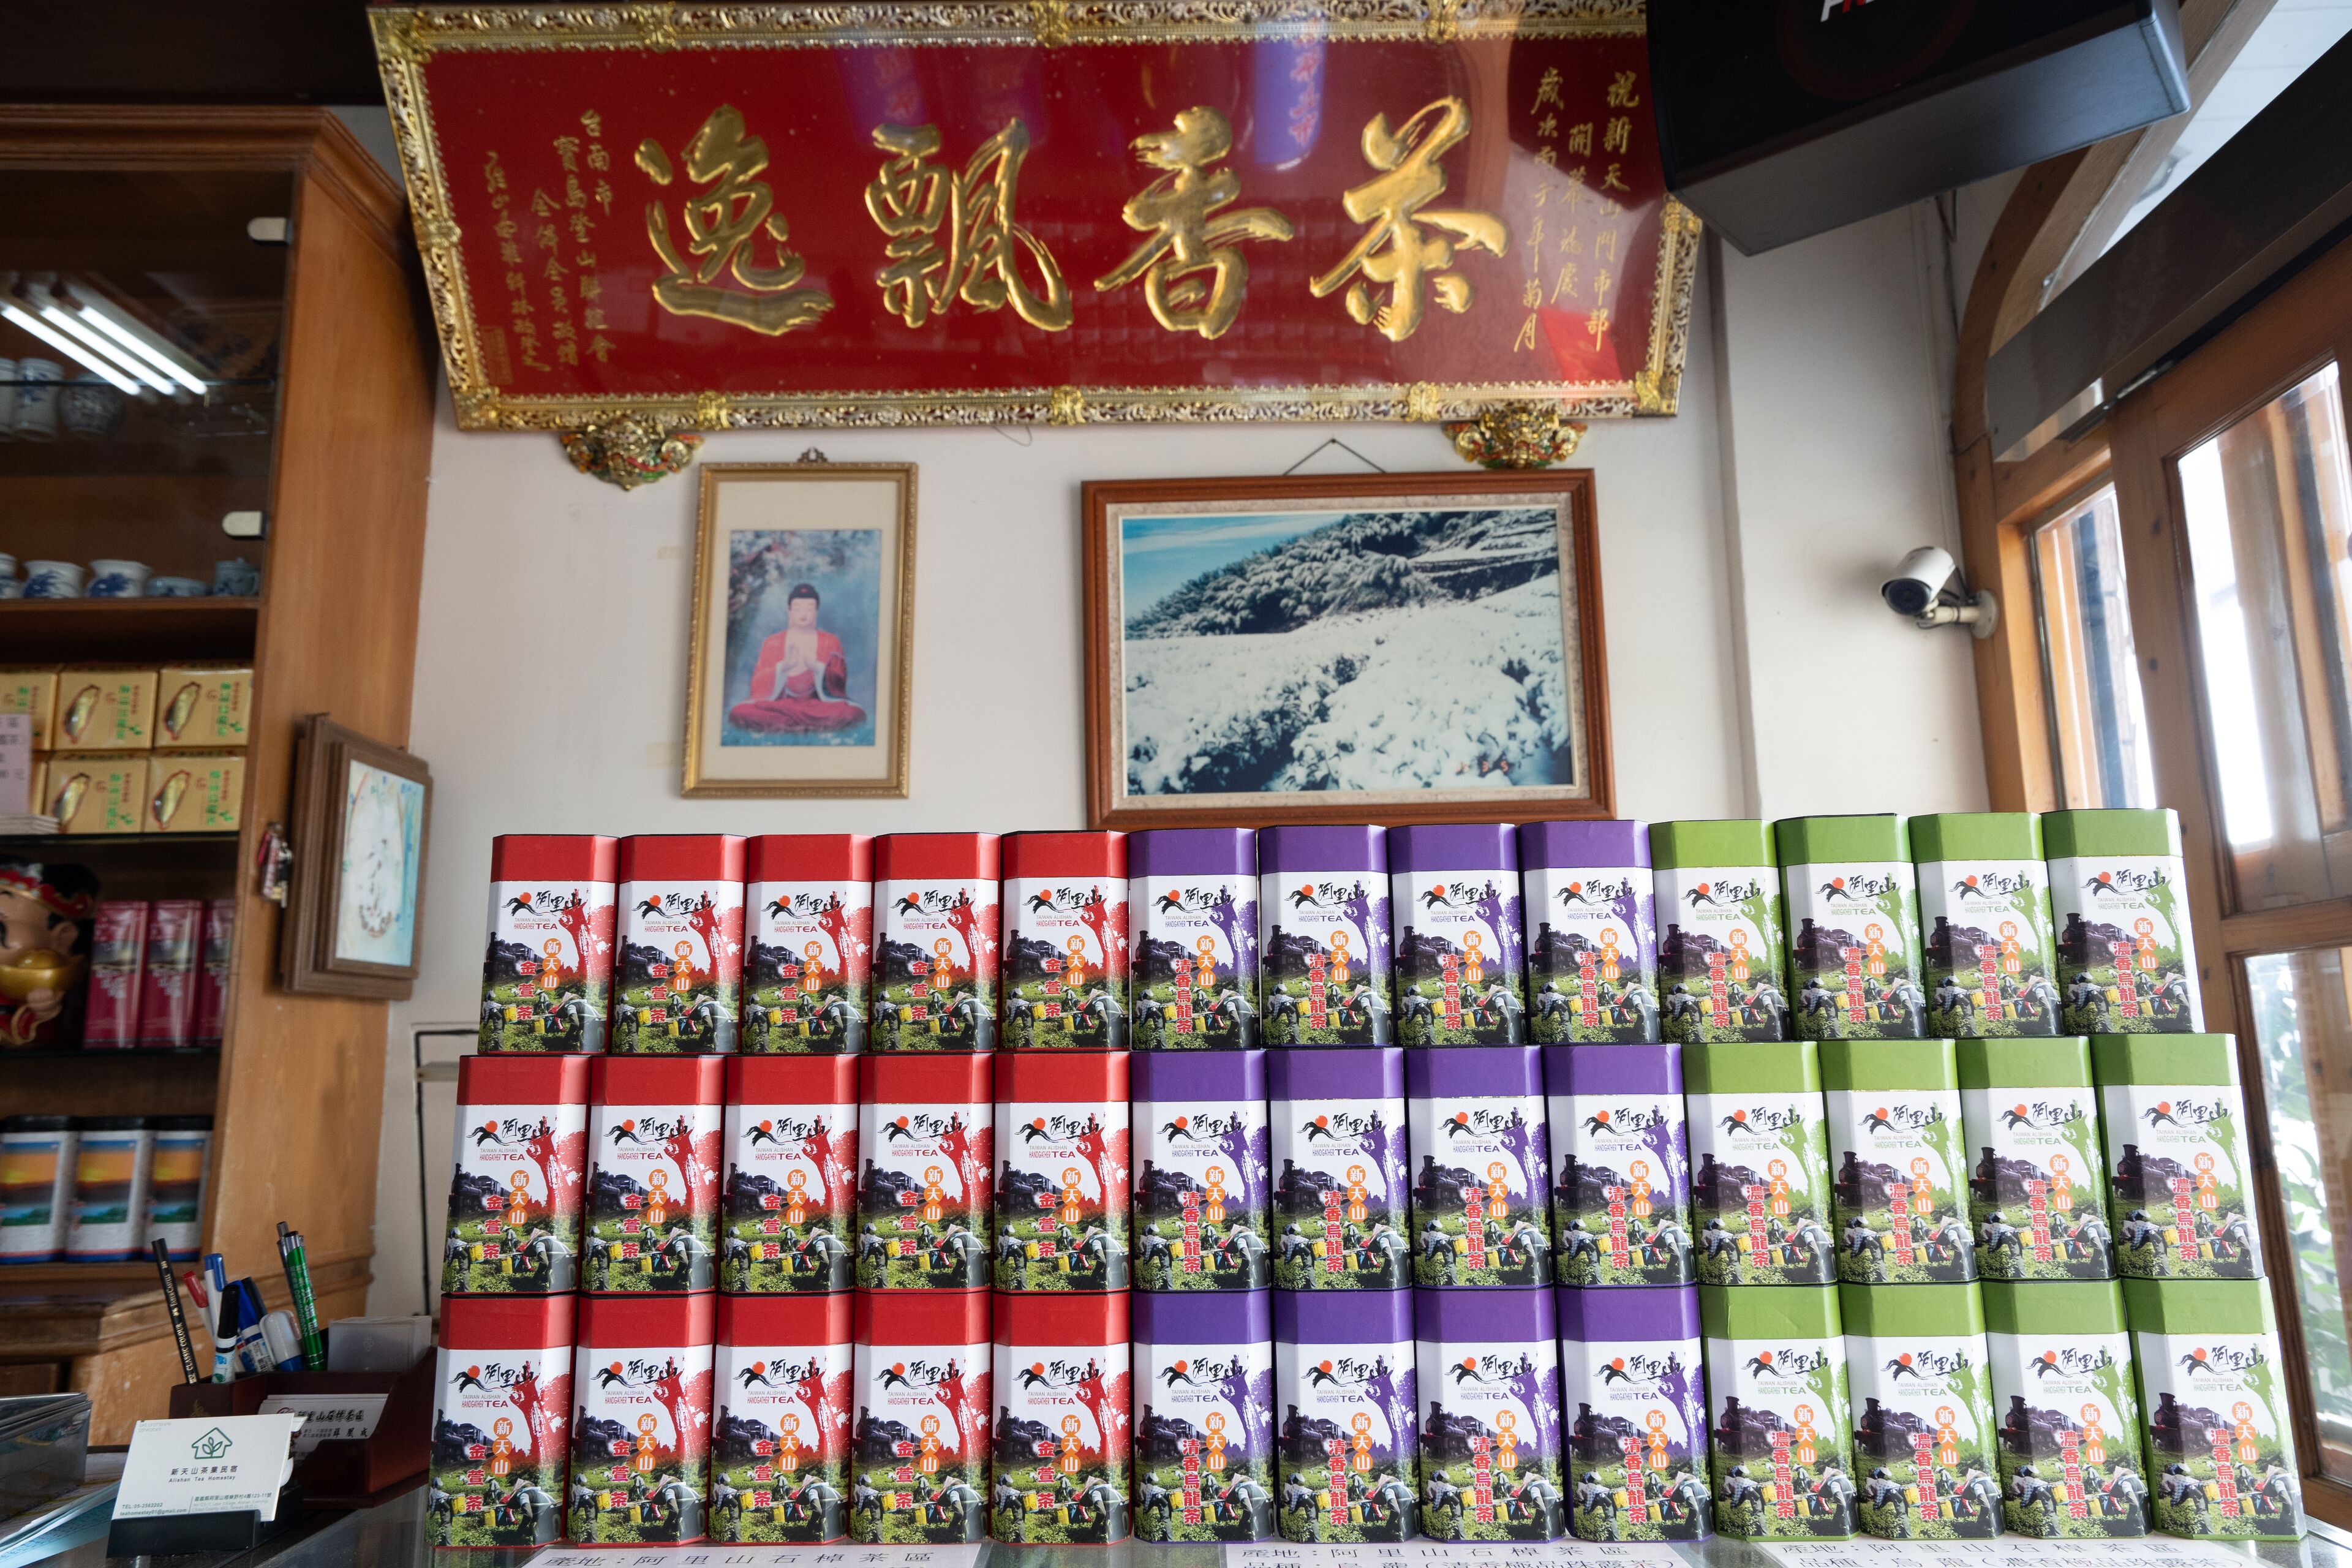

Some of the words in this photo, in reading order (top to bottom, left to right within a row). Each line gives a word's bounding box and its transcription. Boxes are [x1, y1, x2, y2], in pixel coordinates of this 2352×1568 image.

[665, 893, 711, 915] 阿里山
[1319, 883, 1364, 904] 阿里山
[1983, 873, 2029, 895] 阿里山
[544, 941, 559, 988] 新天山
[677, 943, 690, 990] 新天山
[807, 943, 820, 990] 新天山
[937, 940, 949, 988] 新天山
[1070, 938, 1082, 985] 新天山
[1199, 938, 1213, 986] 新天山
[1333, 933, 1347, 981] 新天山
[1466, 933, 1481, 981] 新天山
[1602, 930, 1618, 979] 新天山
[1732, 931, 1747, 979] 新天山
[1867, 925, 1884, 974] 新天山
[2002, 923, 2020, 972] 新天山
[2136, 920, 2156, 969] 新天山
[516, 961, 537, 1020] 金萱茶
[650, 964, 668, 1022] 金萱茶
[781, 964, 798, 1022] 金萱茶
[911, 961, 928, 1020] 金萱茶
[1045, 959, 1061, 1017] 金萱茶
[1175, 959, 1193, 1033] 清香烏龍茶
[1309, 954, 1326, 1029] 清香烏龍茶
[1442, 954, 1461, 1030] 清香烏龍茶
[1579, 952, 1599, 1027] 清香烏龍茶
[1709, 952, 1730, 1027] 濃香烏龍茶
[1844, 948, 1866, 1023] 濃香烏龍茶
[1979, 945, 2003, 1020] 濃香烏龍茶
[2113, 941, 2139, 1017] 濃香烏龍茶
[913, 1114, 962, 1138] 阿里山
[1615, 1107, 1664, 1131] 阿里山
[511, 1172, 527, 1224] 新天山
[650, 1172, 665, 1223] 新天山
[790, 1172, 804, 1223] 新天山
[927, 1169, 941, 1220] 新天山
[1065, 1170, 1079, 1222] 新天山
[1208, 1169, 1223, 1221] 新天山
[1349, 1167, 1365, 1220] 新天山
[1490, 1164, 1506, 1217] 新天山
[1632, 1163, 1649, 1216] 新天山
[1770, 1161, 1789, 1215] 新天山
[1913, 1159, 1932, 1213] 新天山
[2052, 1156, 2071, 1209] 新天山
[2197, 1155, 2217, 1208] 新天山
[483, 1196, 503, 1259] 金萱茶
[622, 1194, 641, 1257] 金萱茶
[763, 1195, 780, 1258] 金萱茶
[900, 1191, 918, 1255] 金萱茶
[1039, 1193, 1056, 1257] 金萱茶
[1183, 1192, 1200, 1273] 清香烏龍茶
[1324, 1191, 1344, 1272] 清香烏龍茶
[1465, 1188, 1485, 1269] 清香烏龍茶
[1608, 1186, 1629, 1268] 清香烏龍茶
[1746, 1185, 1770, 1267] 濃香烏龍茶
[1889, 1183, 1913, 1265] 濃香烏龍茶
[2028, 1180, 2052, 1262] 濃香烏龍茶
[2172, 1178, 2198, 1260] 濃香烏龍茶
[176, 1322, 187, 1346] COLOUR
[182, 1346, 194, 1371] CLASSIC
[484, 1363, 533, 1389] 阿里山
[1193, 1358, 1242, 1382] 阿里山
[1918, 1351, 1968, 1376] 阿里山
[494, 1420, 510, 1474] 新天山
[639, 1416, 654, 1471] 新天山
[782, 1416, 797, 1470] 新天山
[923, 1417, 937, 1472] 新天山
[1065, 1417, 1078, 1472] 新天山
[1208, 1414, 1224, 1470] 新天山
[1354, 1415, 1370, 1470] 新天山
[1498, 1412, 1515, 1468] 新天山
[1648, 1412, 1667, 1468] 新天山
[1796, 1407, 1814, 1463] 新天山
[1938, 1409, 1958, 1464] 新天山
[2083, 1406, 2105, 1462] 新天山
[2234, 1404, 2257, 1461] 新天山
[170, 1464, 238, 1476] 新天山茶業民宿
[466, 1444, 486, 1511] 金萱茶
[610, 1440, 630, 1507] 金萱茶
[754, 1440, 773, 1507] 金萱茶
[895, 1441, 914, 1508] 金萱茶
[1038, 1441, 1055, 1508] 金萱茶
[1183, 1439, 1201, 1524] 清香烏龍茶
[1329, 1439, 1348, 1525] 清香烏龍茶
[1473, 1436, 1493, 1523] 清香烏龍茶
[1623, 1437, 1647, 1523] 清香烏龍茶
[1772, 1431, 1795, 1518] 濃香烏龍茶
[1913, 1433, 1939, 1520] 濃香烏龍茶
[2059, 1431, 2087, 1518] 濃香烏龍茶
[2211, 1429, 2241, 1517] 濃香烏龍茶
